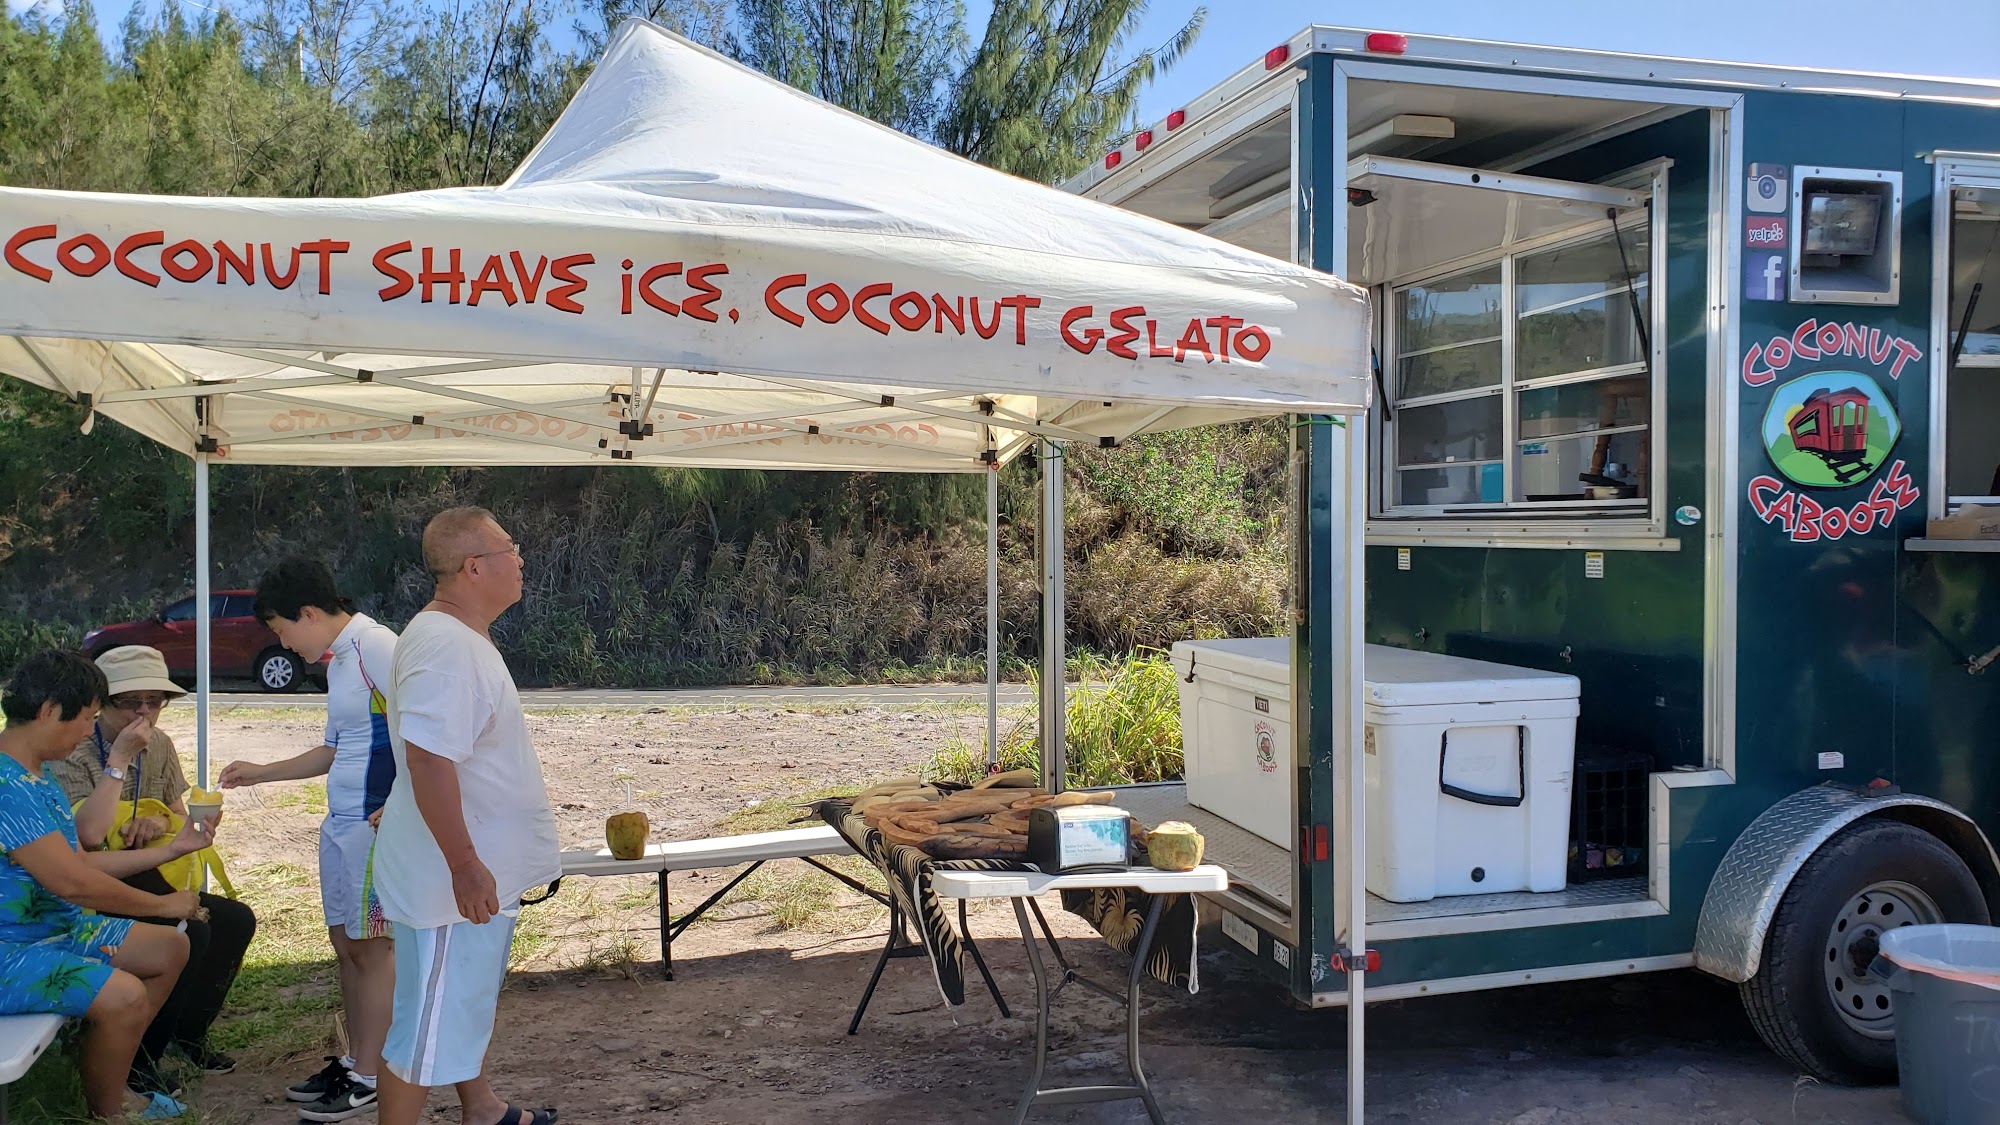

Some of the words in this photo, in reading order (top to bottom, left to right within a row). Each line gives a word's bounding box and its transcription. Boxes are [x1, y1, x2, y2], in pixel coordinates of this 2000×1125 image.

[1748, 227, 1773, 243] yelp
[4, 224, 350, 295] COCONUT
[372, 240, 595, 314] SHAVE
[764, 273, 1041, 346] COCONUT
[1060, 305, 1272, 362] GELATO
[1743, 318, 1923, 387] COCONUT
[1747, 460, 1920, 542] CABOOSE
